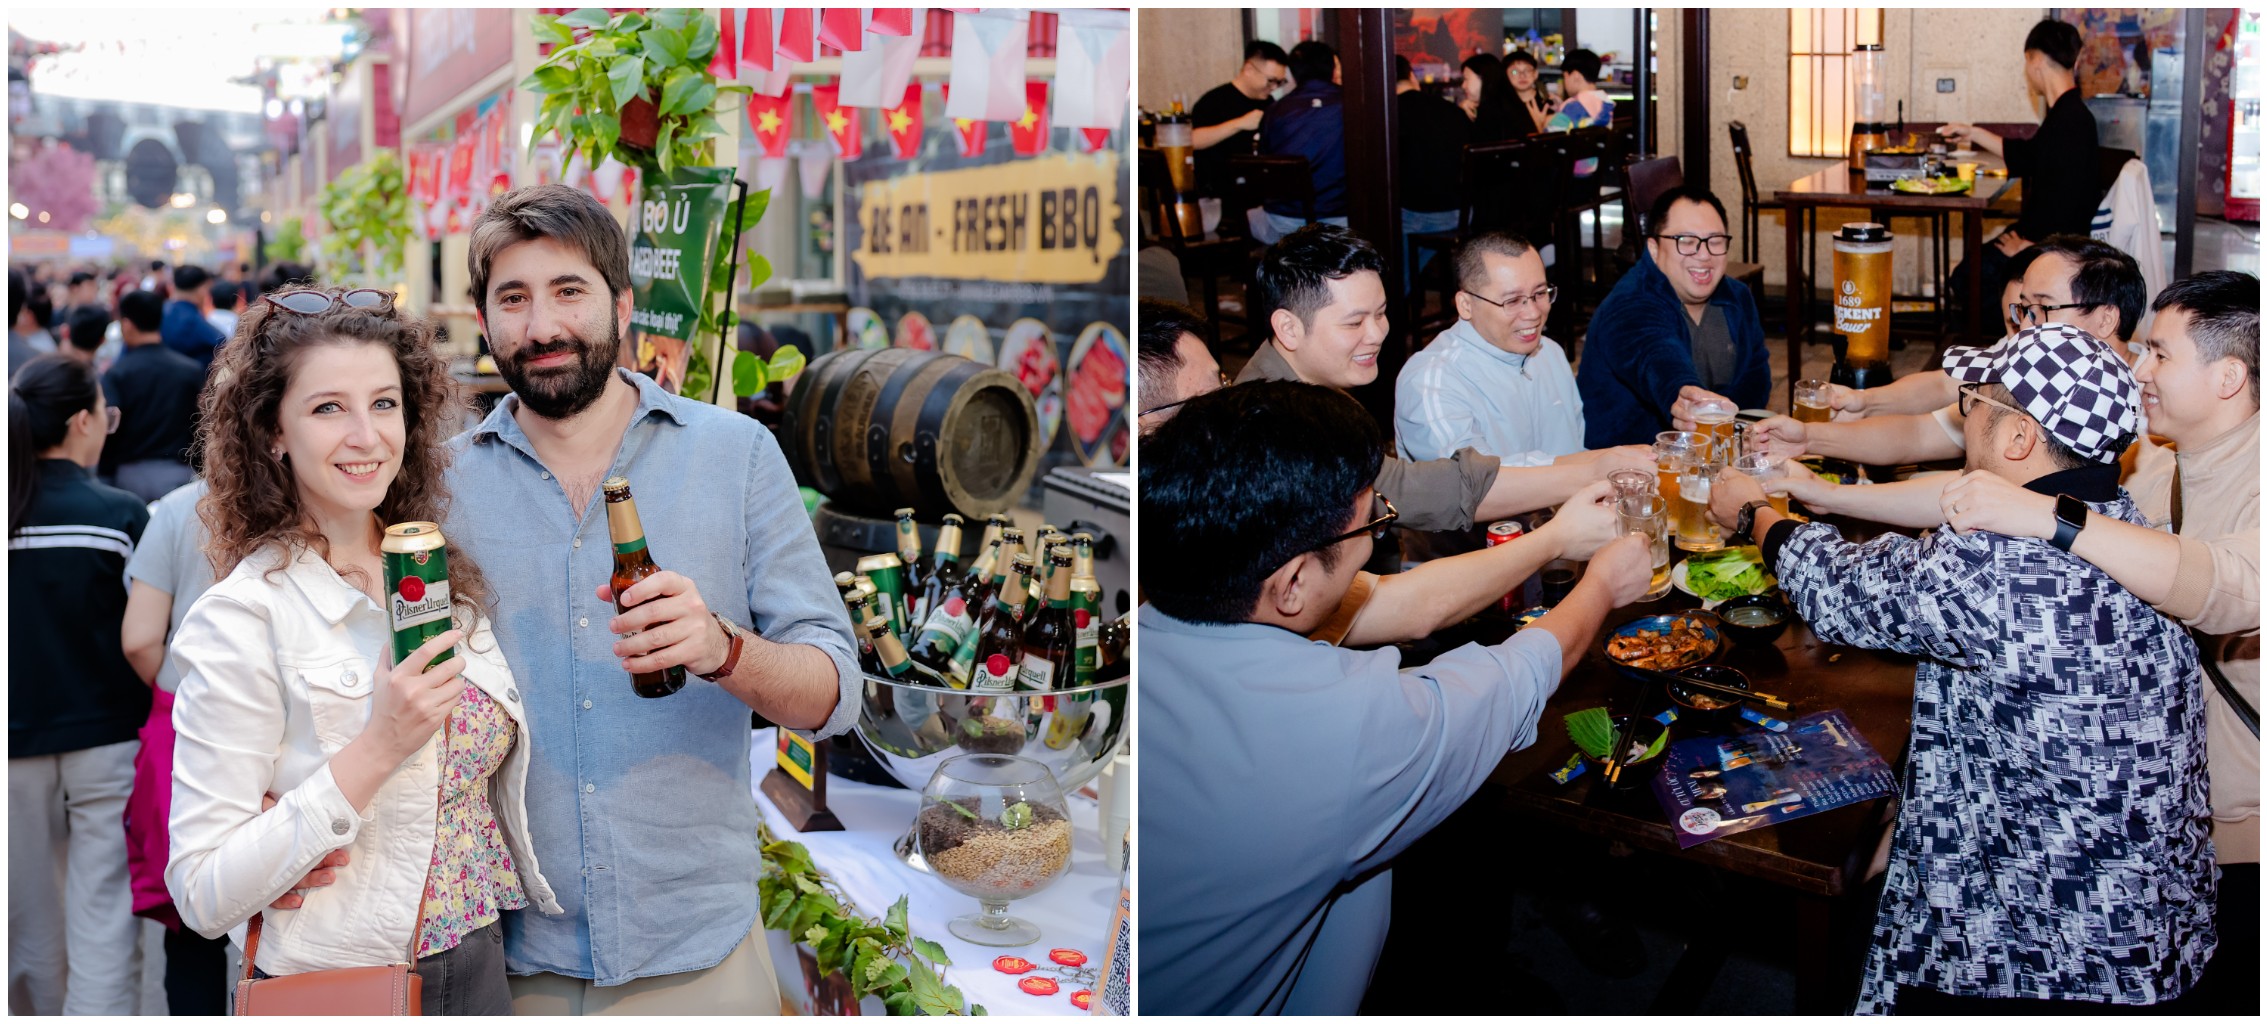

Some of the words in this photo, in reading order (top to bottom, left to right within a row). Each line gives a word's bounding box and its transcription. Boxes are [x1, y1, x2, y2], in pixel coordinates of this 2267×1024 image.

[643, 190, 669, 234] BÒ
[673, 192, 691, 235] Ủ
[953, 192, 1027, 252] FRESH
[1040, 186, 1099, 263] BBQ
[653, 247, 681, 280] BEEF
[1839, 294, 1862, 307] 1689
[396, 599, 426, 620] Pilsner
[976, 669, 1004, 688] Pilsner
